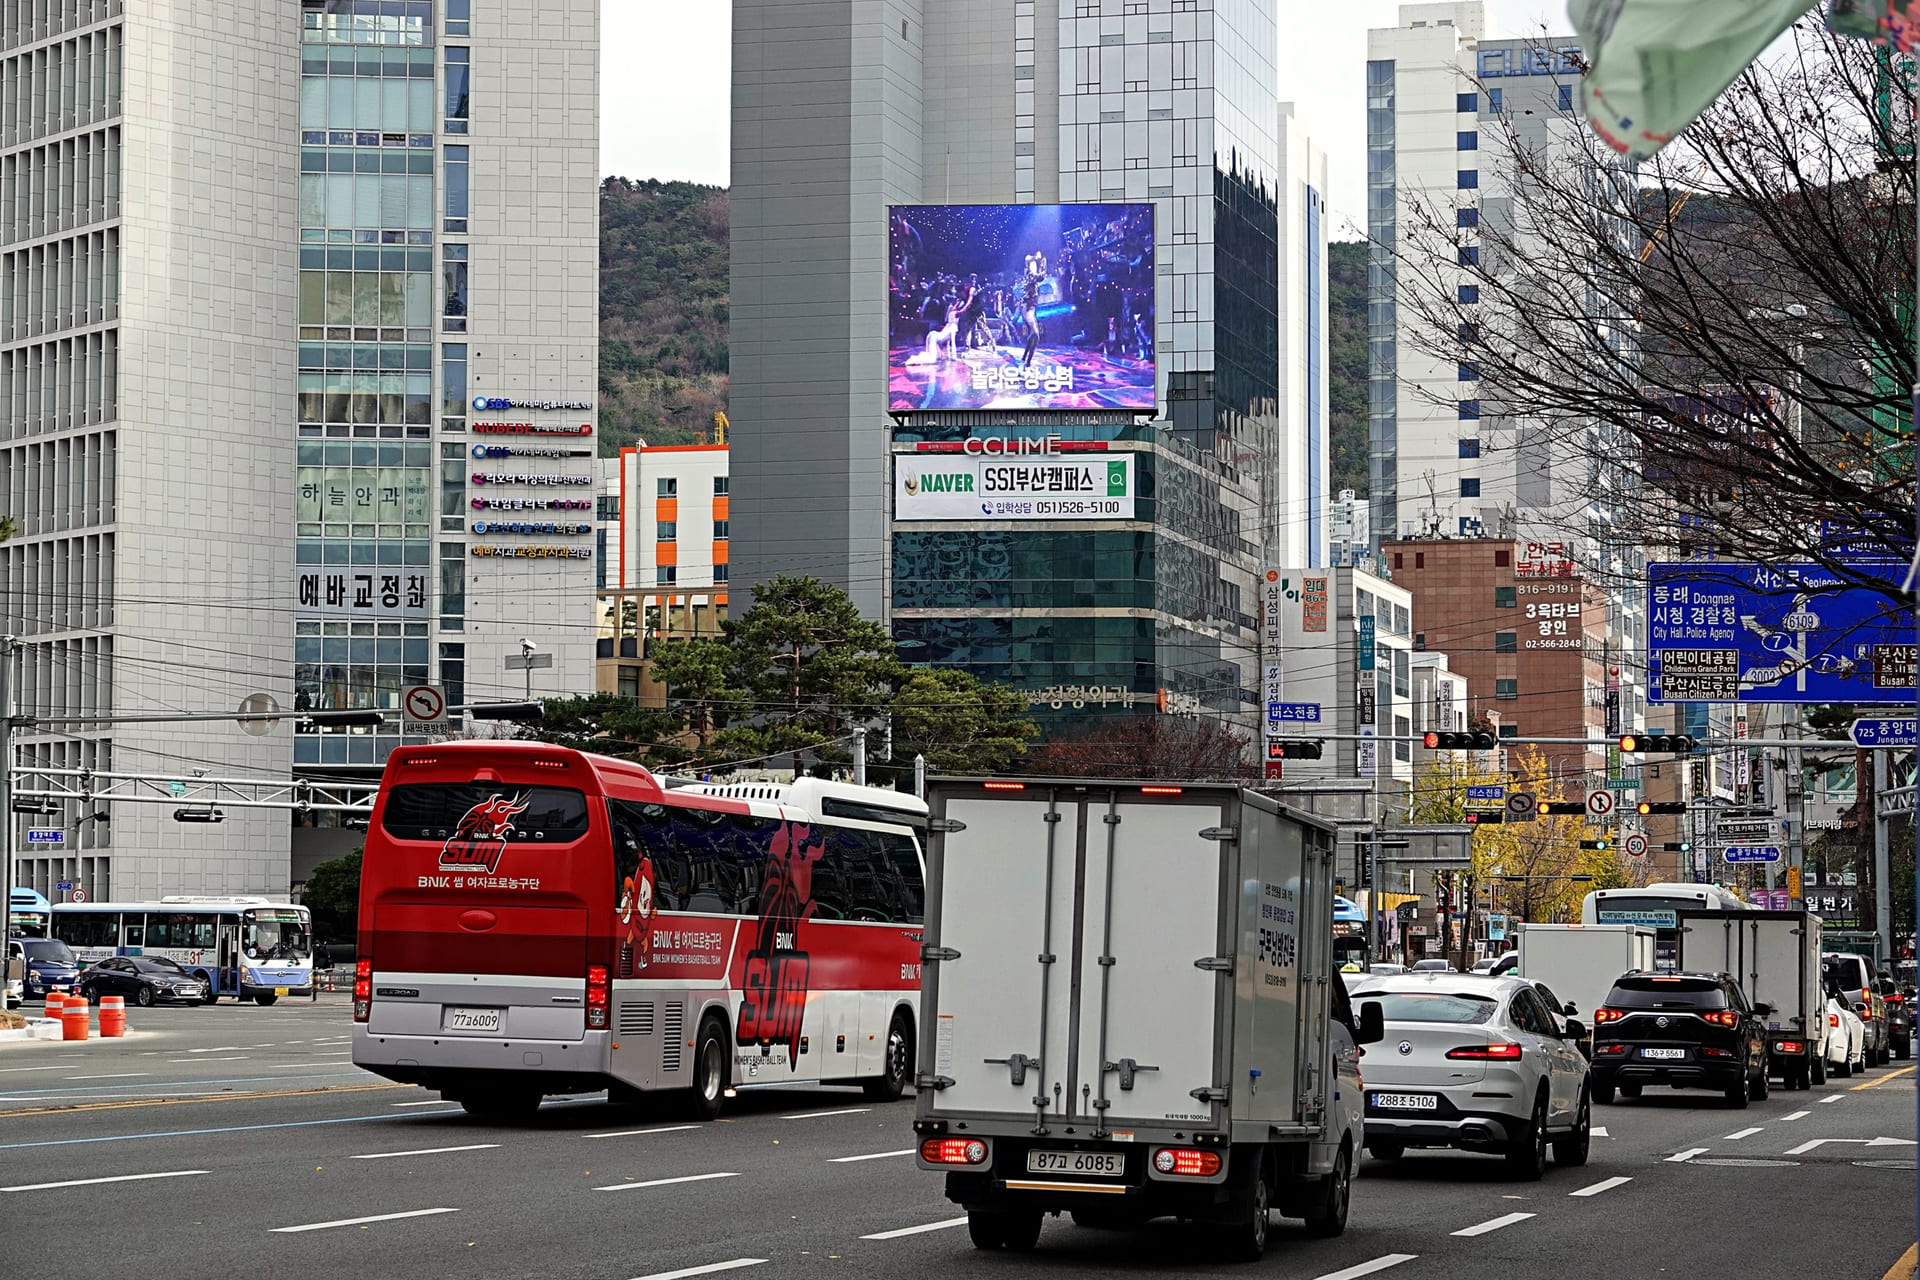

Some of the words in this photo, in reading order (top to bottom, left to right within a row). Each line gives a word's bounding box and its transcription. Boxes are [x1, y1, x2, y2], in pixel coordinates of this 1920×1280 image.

[1478, 46, 1583, 78] CUBE
[920, 474, 974, 493] NAVER
[984, 466, 1094, 491] SSI부산캠퍼스
[301, 483, 400, 507] 하늘안과
[996, 502, 1032, 514] 입학상담
[1036, 501, 1120, 514] 051)526-5100
[1527, 542, 1564, 559] 한국
[1305, 580, 1325, 592] 임대
[1653, 585, 1689, 604] 동래
[1693, 592, 1735, 606] Dongnae
[1525, 603, 1580, 618] 3옥타브
[1266, 587, 1280, 658] 삼성피부과
[1538, 620, 1567, 636] 장인
[1788, 615, 1814, 628] 6109
[1653, 626, 1667, 641] City
[1709, 627, 1735, 641] Agency
[1525, 639, 1582, 649] 02-566-2848
[1772, 635, 1782, 649] 7
[1664, 651, 1737, 665] 어린이대공원
[1819, 657, 1830, 671] 7
[1697, 664, 1718, 673] Grand
[1719, 665, 1735, 673] Park
[1880, 676, 1906, 686] Busan
[1664, 690, 1688, 699] Busan
[1689, 690, 1719, 699] Citizen
[1720, 690, 1736, 699] Park
[1270, 705, 1317, 719] 버스전용
[406, 724, 448, 735] 새싹로방향
[1858, 728, 1875, 737] 725
[1877, 736, 1917, 745] Jungang-d
[1468, 787, 1502, 798] 버스전용
[1630, 841, 1642, 850] 50
[441, 841, 504, 873] SUM
[418, 876, 450, 888] BNK
[454, 876, 463, 888] 썸
[467, 876, 540, 890] 여자프로농구단
[653, 930, 672, 948] BNK
[674, 931, 681, 949] 썸
[682, 932, 722, 950] 여자프로농구단
[776, 932, 793, 949] BNK
[189, 952, 200, 965] 31
[710, 955, 721, 965] TEAM
[738, 957, 808, 1072] SUM
[734, 1055, 752, 1065] WOMEN'S
[753, 1055, 776, 1065] BASKETBALL
[776, 1055, 787, 1065] TEAM
[1666, 1050, 1683, 1058] 5561
[1380, 1094, 1406, 1106] 288조
[1409, 1095, 1435, 1108] 5106
[1037, 1153, 1068, 1170] 87고
[1074, 1154, 1116, 1171] 6085
